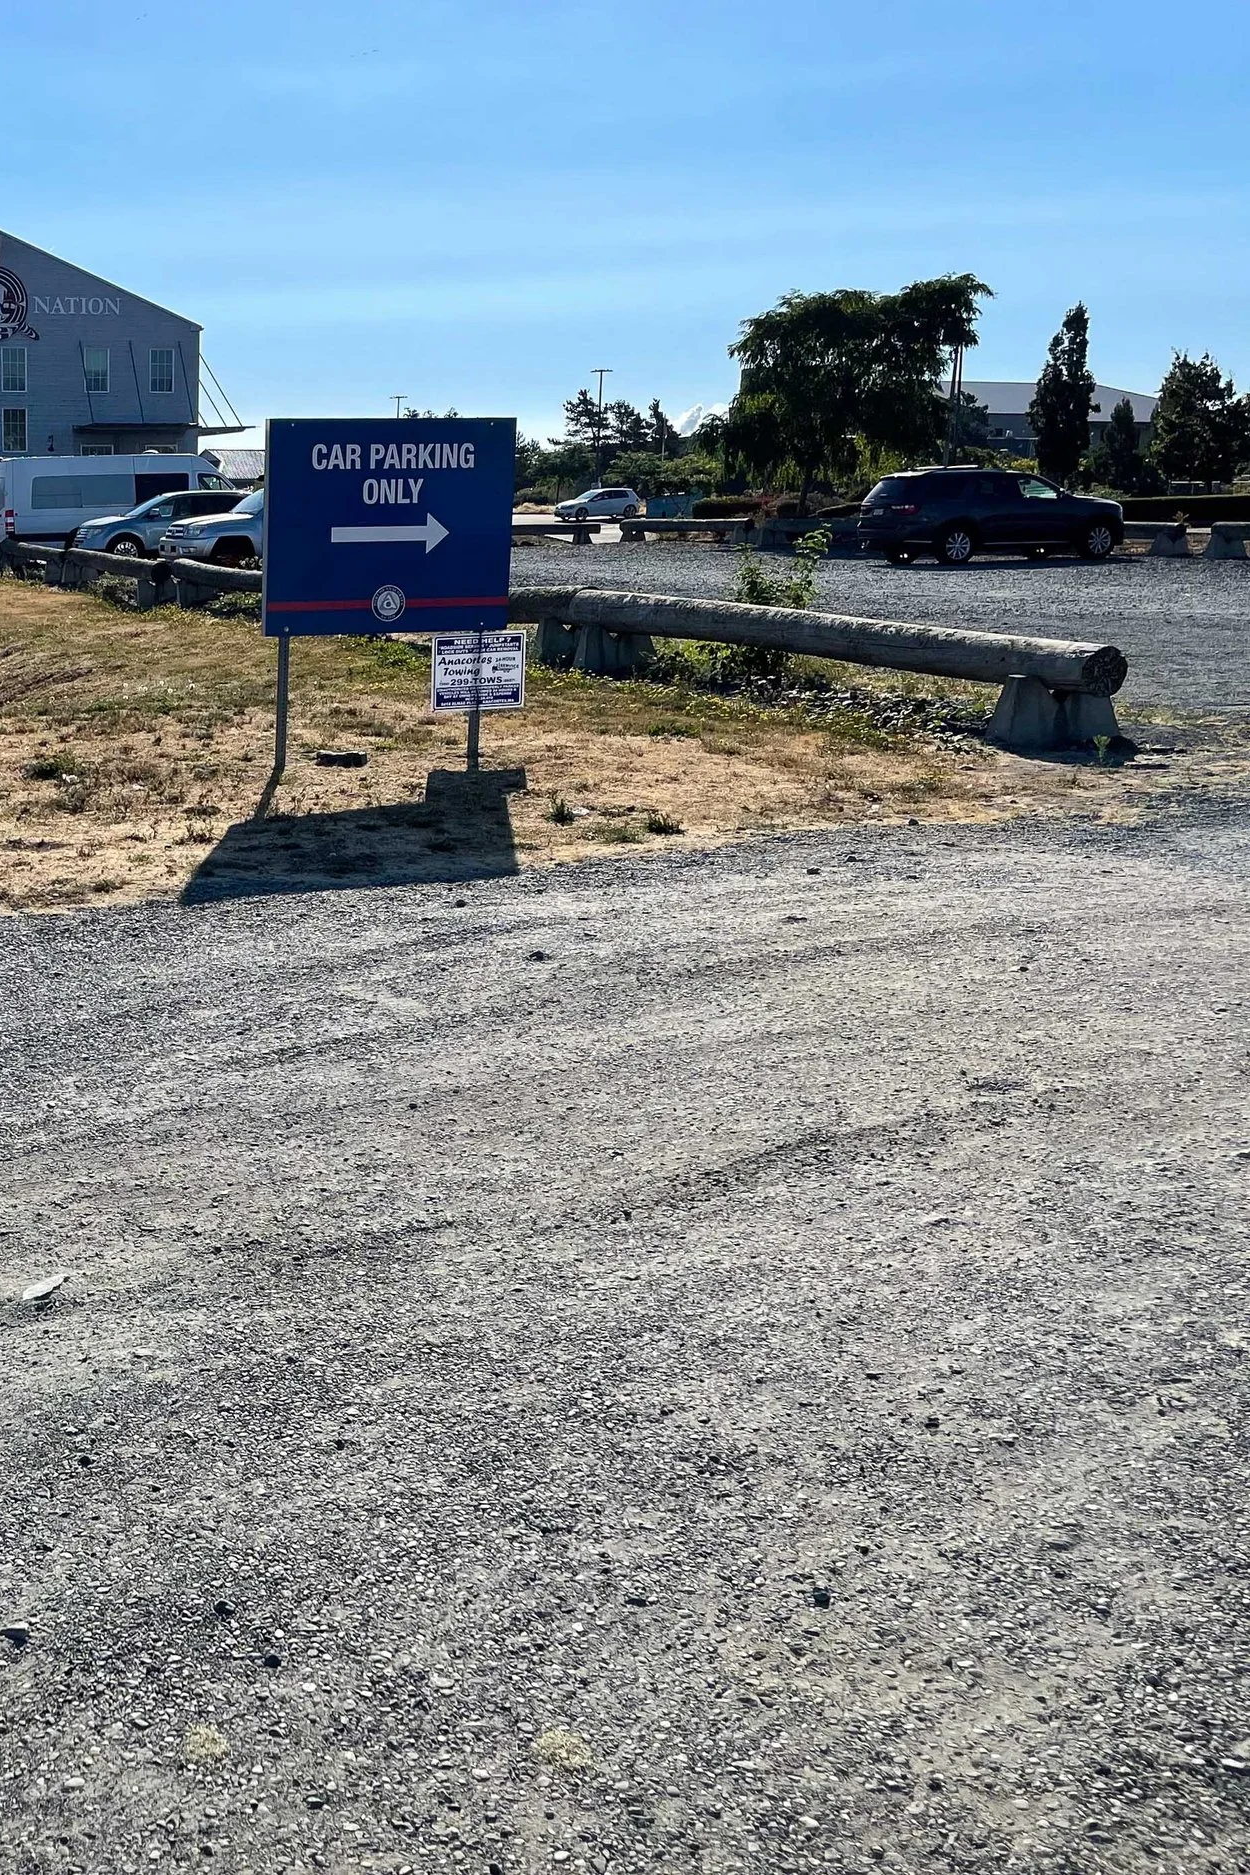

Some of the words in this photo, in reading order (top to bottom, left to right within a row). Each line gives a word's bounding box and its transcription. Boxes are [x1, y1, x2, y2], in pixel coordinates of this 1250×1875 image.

[32, 296, 123, 316] NATION
[311, 443, 362, 470] CAR
[369, 442, 475, 469] PARKING
[362, 478, 424, 505] ONLY
[438, 656, 493, 667] Anacortes
[443, 666, 480, 677] Towing
[450, 676, 503, 686] 299-TOWS
